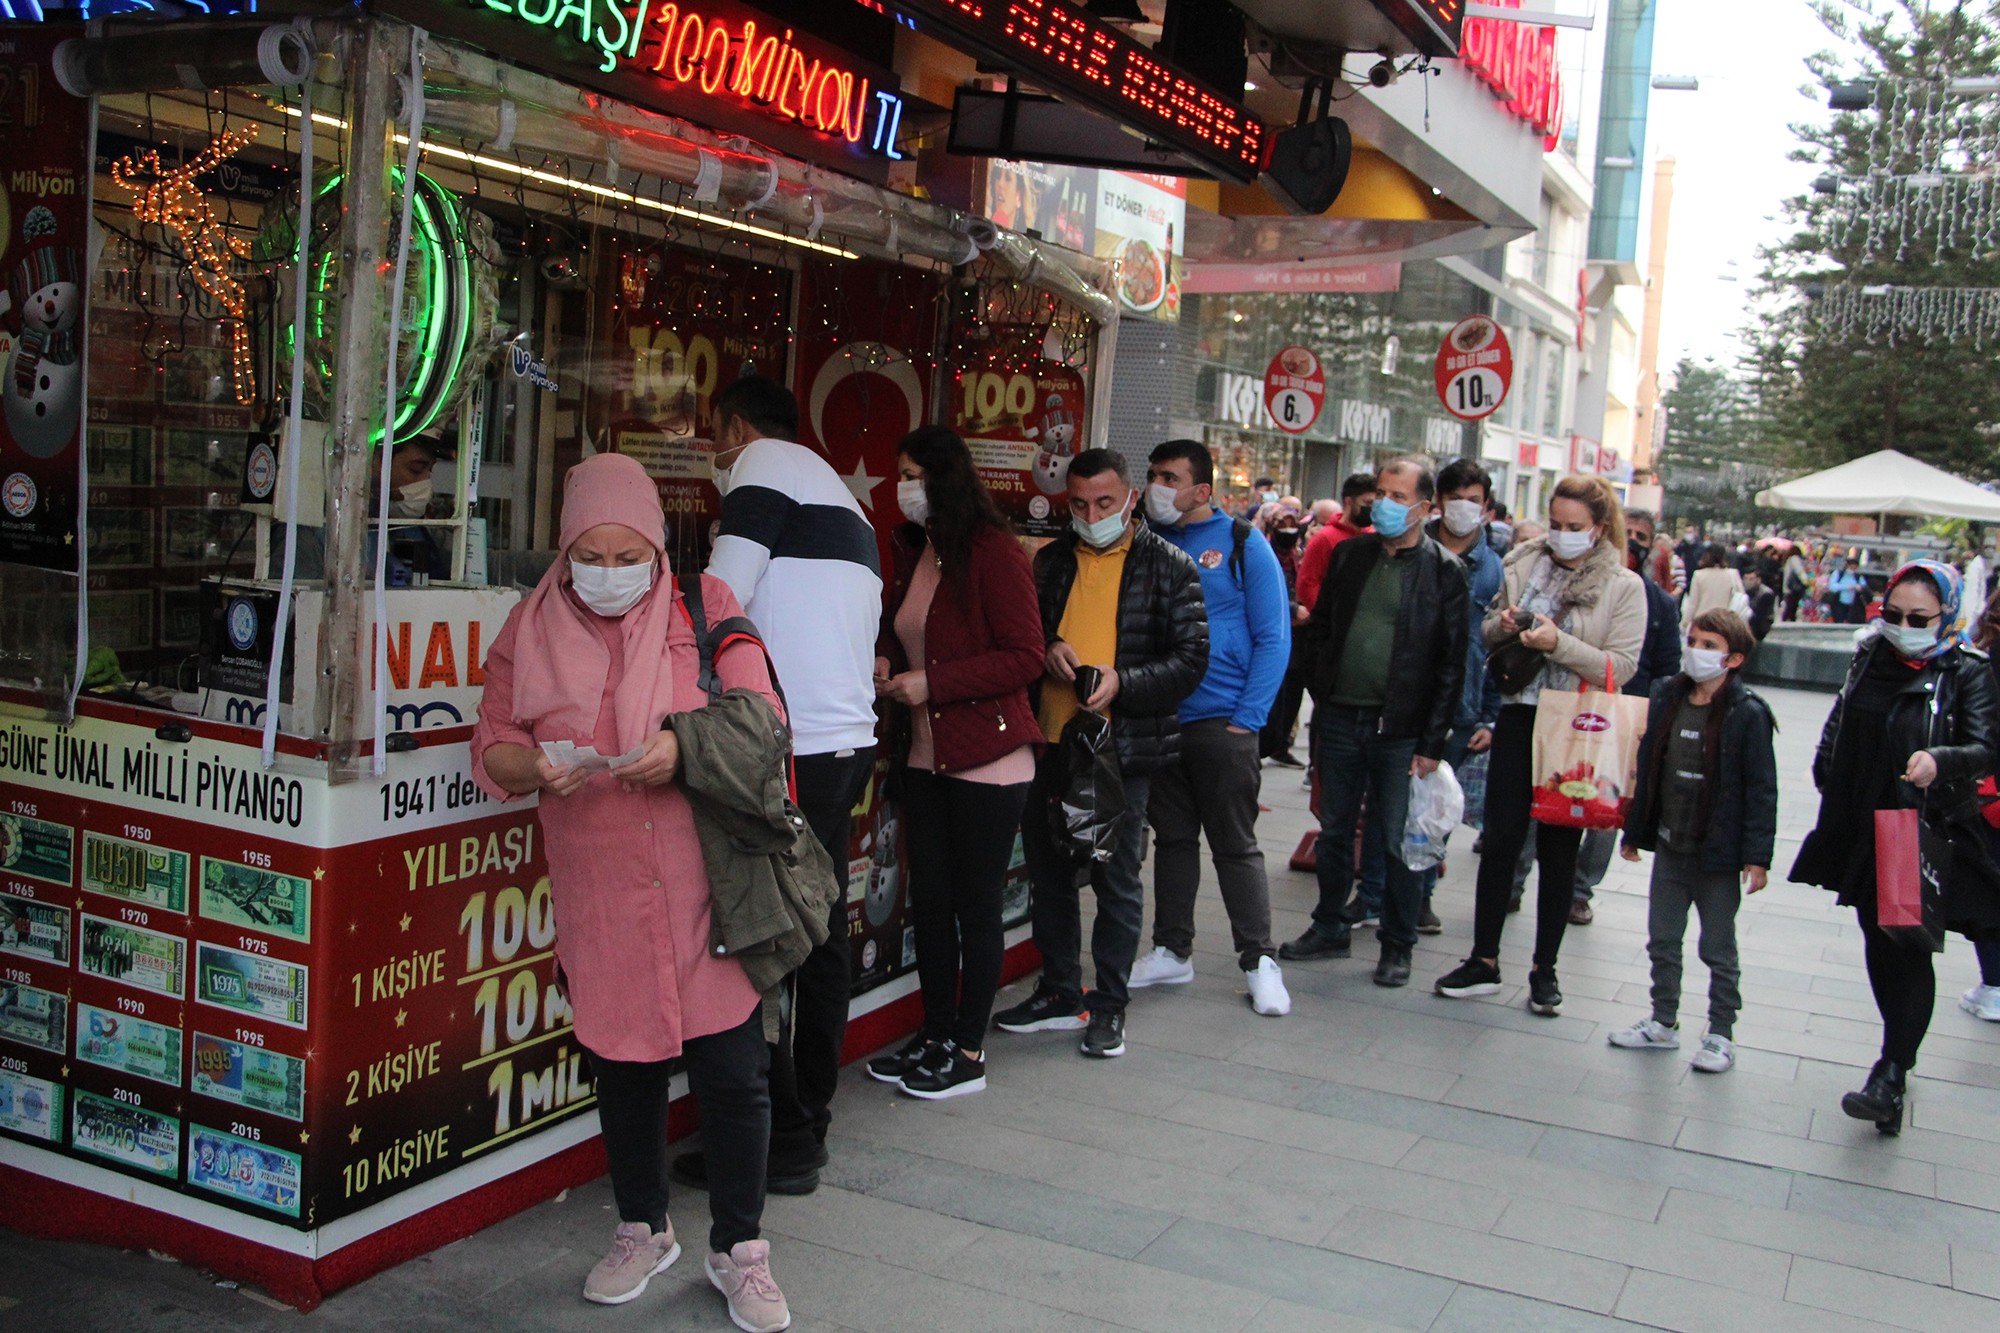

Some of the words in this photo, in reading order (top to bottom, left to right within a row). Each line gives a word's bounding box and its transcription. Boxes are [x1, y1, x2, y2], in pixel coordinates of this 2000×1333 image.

[876, 91, 902, 160] TL
[11, 170, 76, 198] Milyon
[241, 183, 275, 199] piyango
[1104, 190, 1115, 205] ET
[1116, 194, 1142, 217] DÖNER
[530, 361, 547, 376] milli
[629, 325, 718, 398] 100
[530, 372, 559, 391] piyango
[1455, 374, 1483, 410] 10
[961, 371, 1035, 418] 100
[1037, 380, 1070, 392] Milyon
[1284, 393, 1296, 422] 6
[1341, 399, 1391, 444] KOTON
[1426, 416, 1463, 455] KOTON
[987, 471, 1020, 481] İKRAMİYE
[1014, 482, 1026, 492] TL
[694, 498, 708, 513] TL
[0, 725, 48, 776] GÜNE
[55, 726, 114, 789] ÜNAL
[123, 742, 189, 803] MİLLİ
[196, 755, 303, 828] PİYANGO
[11, 800, 38, 816] 1945
[123, 824, 151, 840] 1950
[242, 849, 271, 868] 1955
[403, 824, 534, 892] YILBAŞI
[8, 881, 34, 898] 1965
[120, 907, 148, 925] 1970
[239, 936, 268, 954] 1975
[6, 967, 31, 985] 1985
[211, 973, 240, 994] 1975
[352, 973, 361, 1008] 1
[372, 949, 446, 1002] KİŞİYE
[117, 997, 144, 1014] 1990
[474, 969, 538, 1056] 10
[235, 1028, 265, 1046] 1995
[2, 1056, 28, 1073] 2005
[196, 1048, 232, 1072] 1995
[346, 1070, 360, 1106] 2
[368, 1041, 441, 1098] KİŞİYE
[113, 1087, 141, 1106] 2010
[488, 1060, 513, 1135] 1
[521, 1046, 597, 1124] MİL
[231, 1121, 260, 1141] 2015
[202, 1143, 255, 1187] 2015
[343, 1158, 370, 1199] 10
[377, 1125, 449, 1185] KİŞİYE
